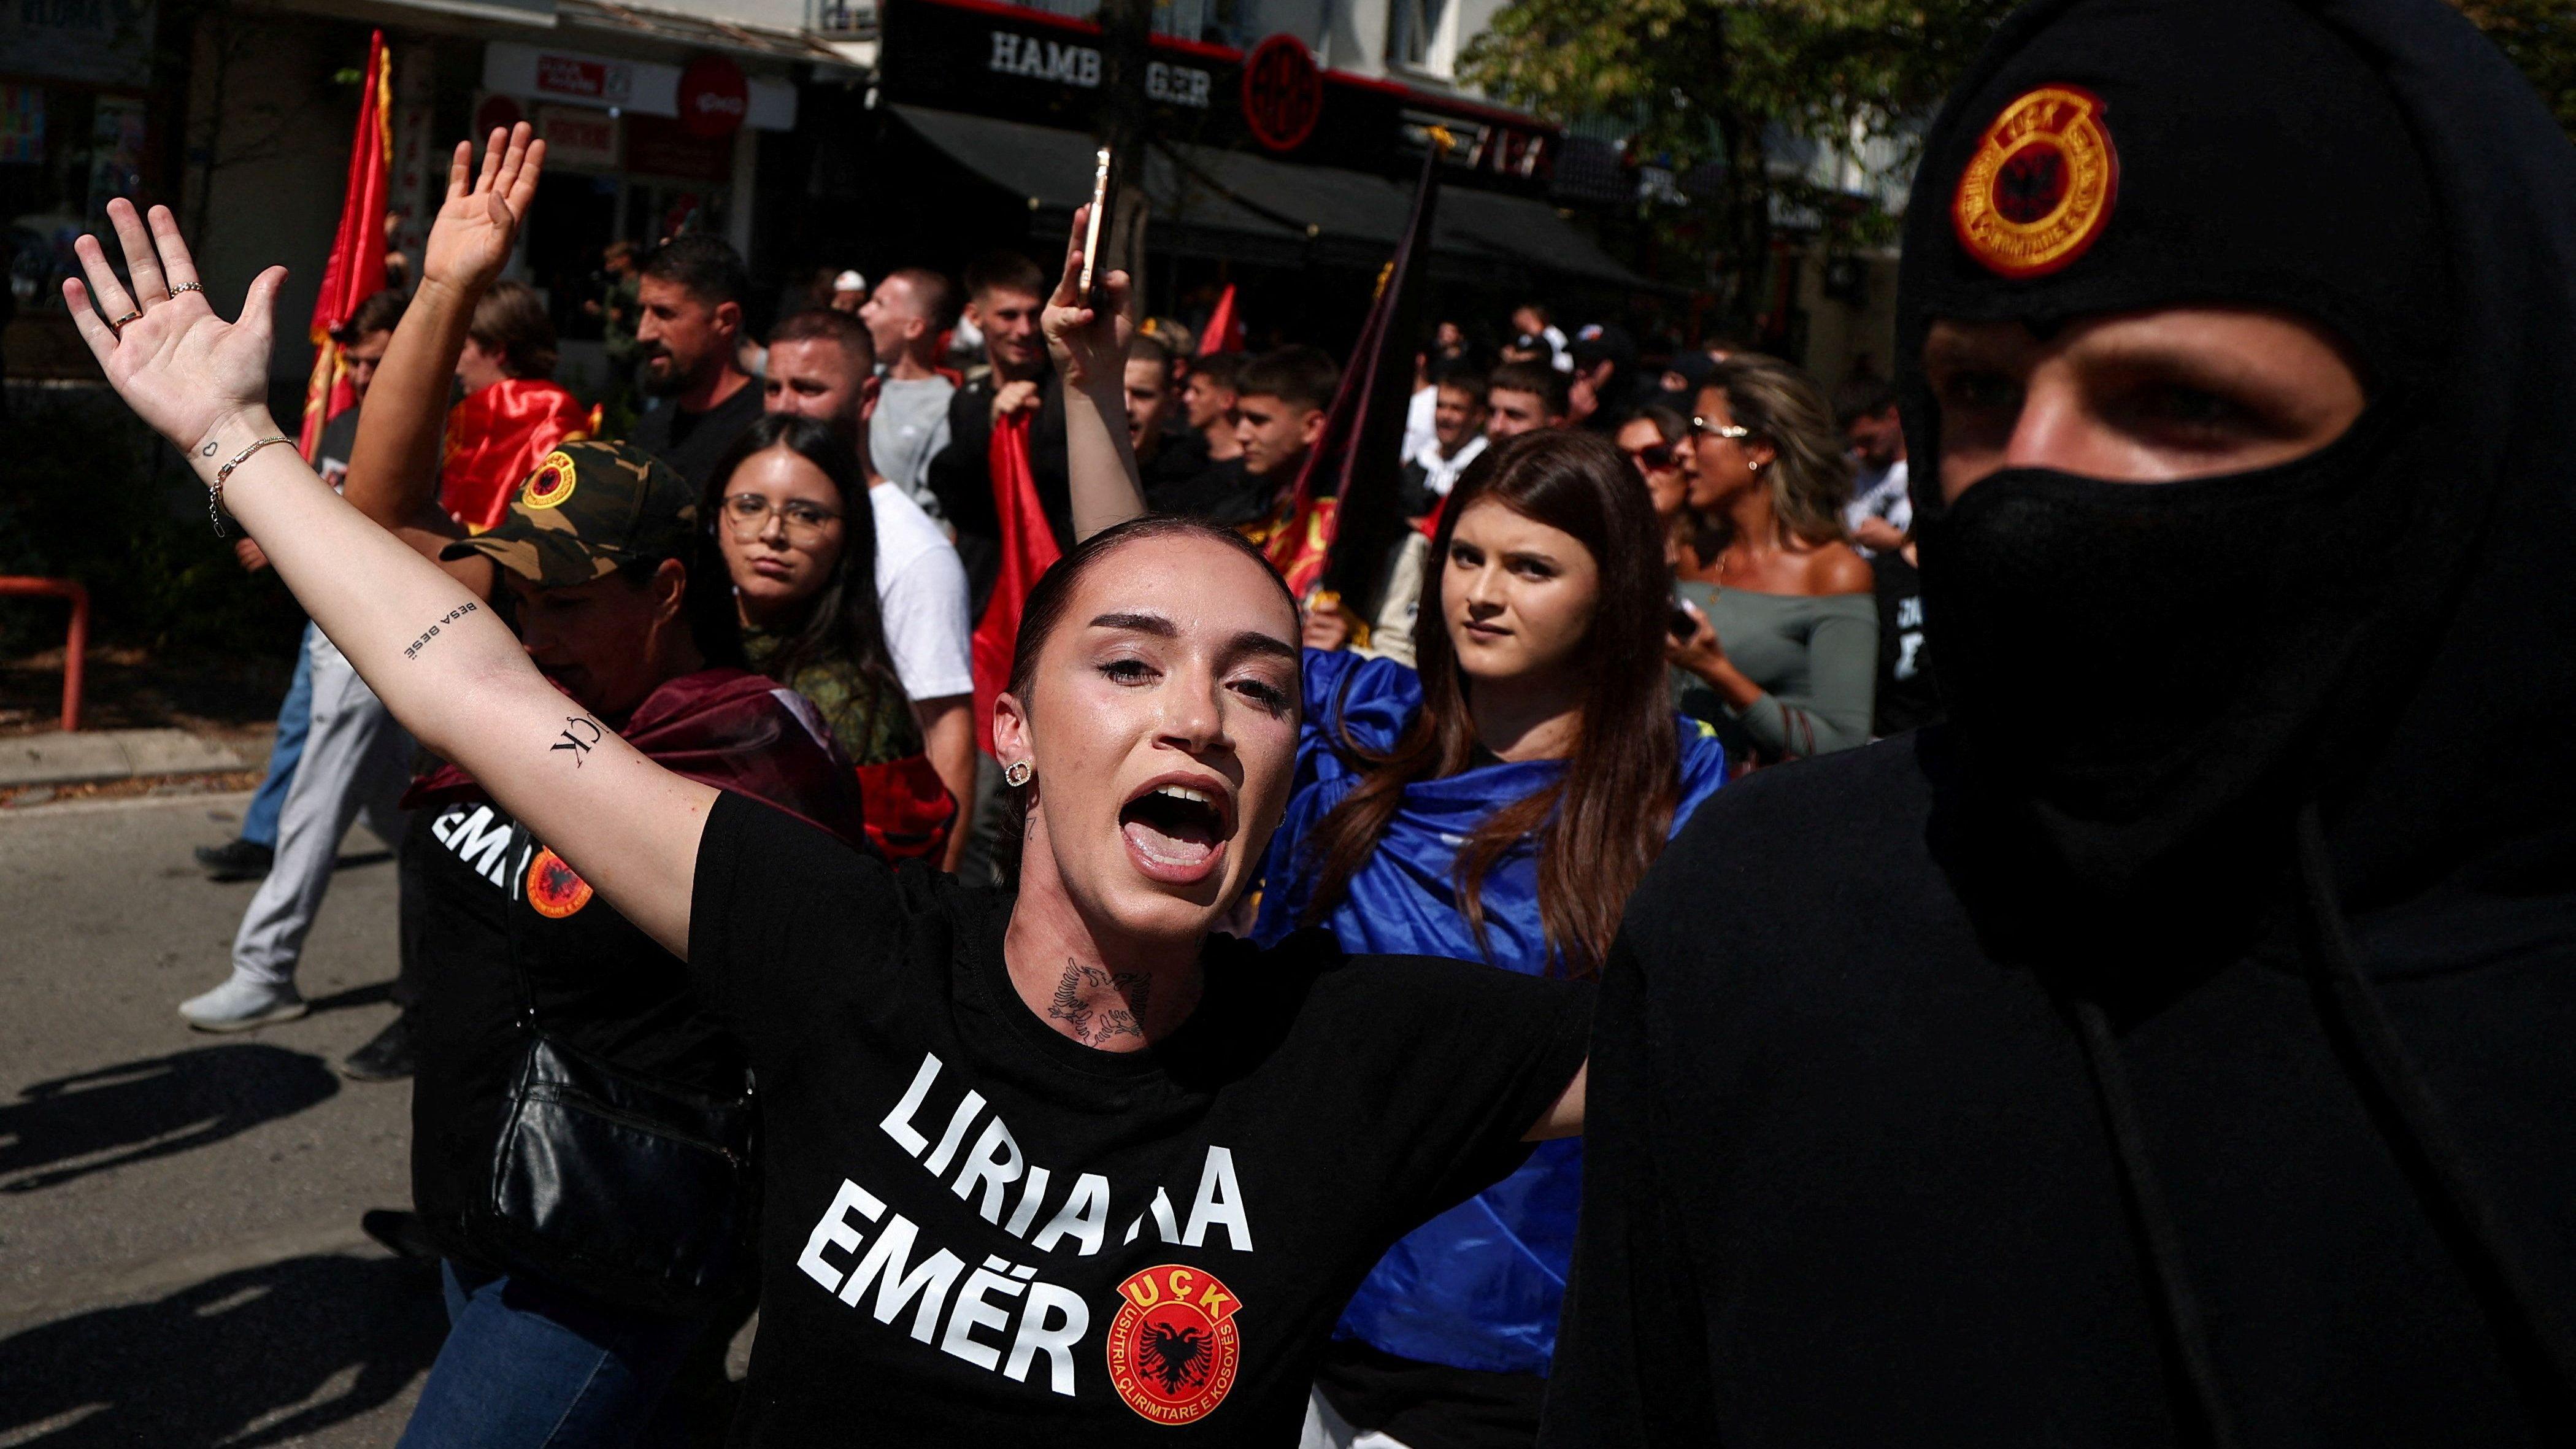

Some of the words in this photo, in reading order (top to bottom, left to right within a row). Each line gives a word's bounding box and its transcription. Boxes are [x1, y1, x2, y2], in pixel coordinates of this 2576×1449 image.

[990, 31, 1211, 109] HAMBGER
[404, 625, 440, 661] BESË
[440, 602, 477, 625] BESA
[879, 1051, 1110, 1256] LIRIA
[798, 1178, 1090, 1397] EMËR
[1128, 1270, 1231, 1319] UÇK
[1112, 1307, 1137, 1376] USHTRIA
[1210, 1324, 1234, 1400] KOSOVËS
[1117, 1377, 1199, 1420] ÇLIRIMTARE
[1201, 1396, 1212, 1410] E
